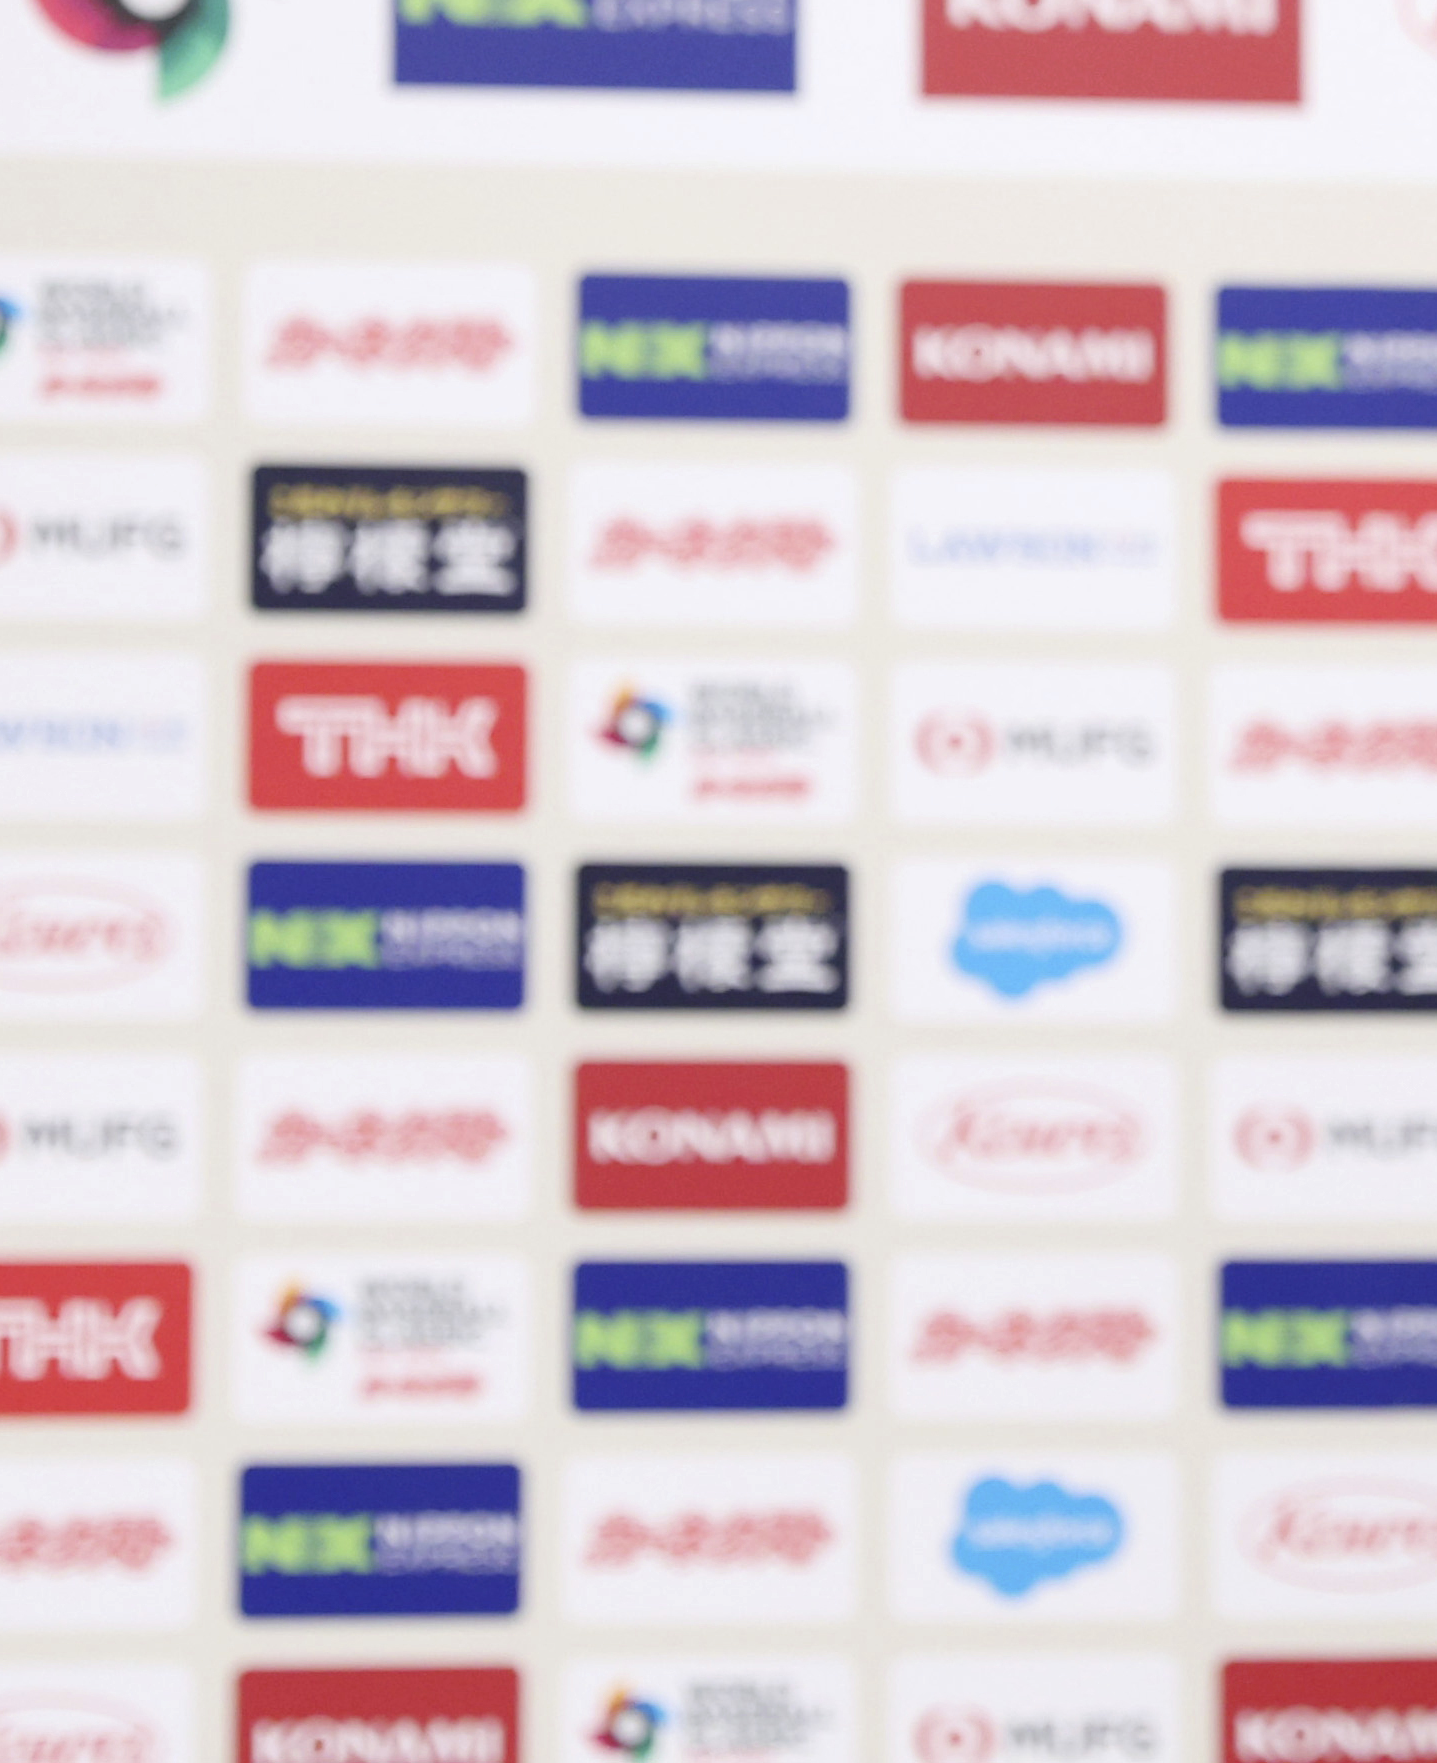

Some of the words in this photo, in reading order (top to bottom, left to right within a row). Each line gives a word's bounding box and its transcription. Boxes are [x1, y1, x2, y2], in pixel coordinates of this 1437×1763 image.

[913, 325, 1154, 382] KONAMI
[275, 696, 497, 778] THK
[587, 1108, 837, 1165] KONAMI
[250, 1717, 506, 1763] KONAMI
